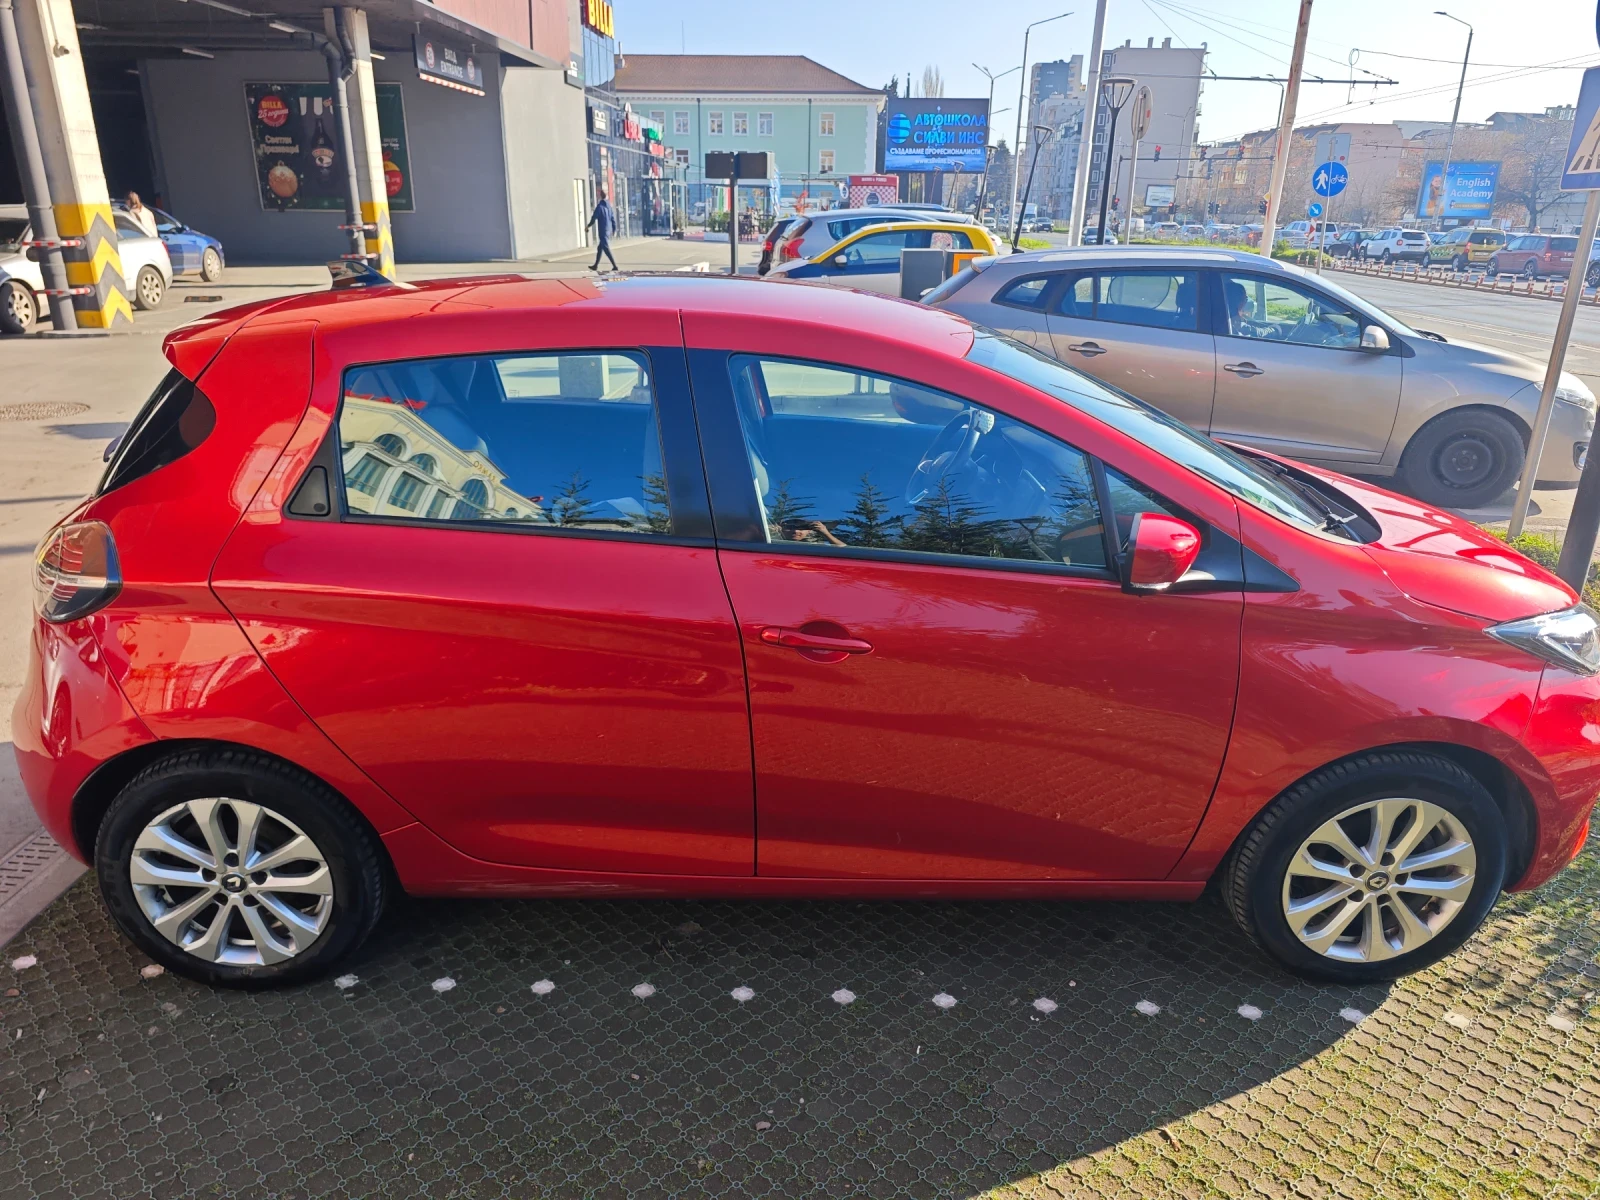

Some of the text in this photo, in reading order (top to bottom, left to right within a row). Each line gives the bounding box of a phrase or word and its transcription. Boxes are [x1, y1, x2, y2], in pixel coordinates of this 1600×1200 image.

[588, 0, 614, 39] BILLA
[440, 60, 464, 78] ENTRANCE
[261, 101, 282, 109] BILLA
[258, 109, 267, 119] 25
[914, 113, 986, 127] АВТОШКОЛА
[914, 131, 985, 145] СИЛВИ ИНС
[889, 147, 982, 155] СЪЗДАВАМЕ ПРОФЕСИОНАЛИСТИ
[1456, 177, 1491, 188] English
[1449, 188, 1493, 200] Academy
